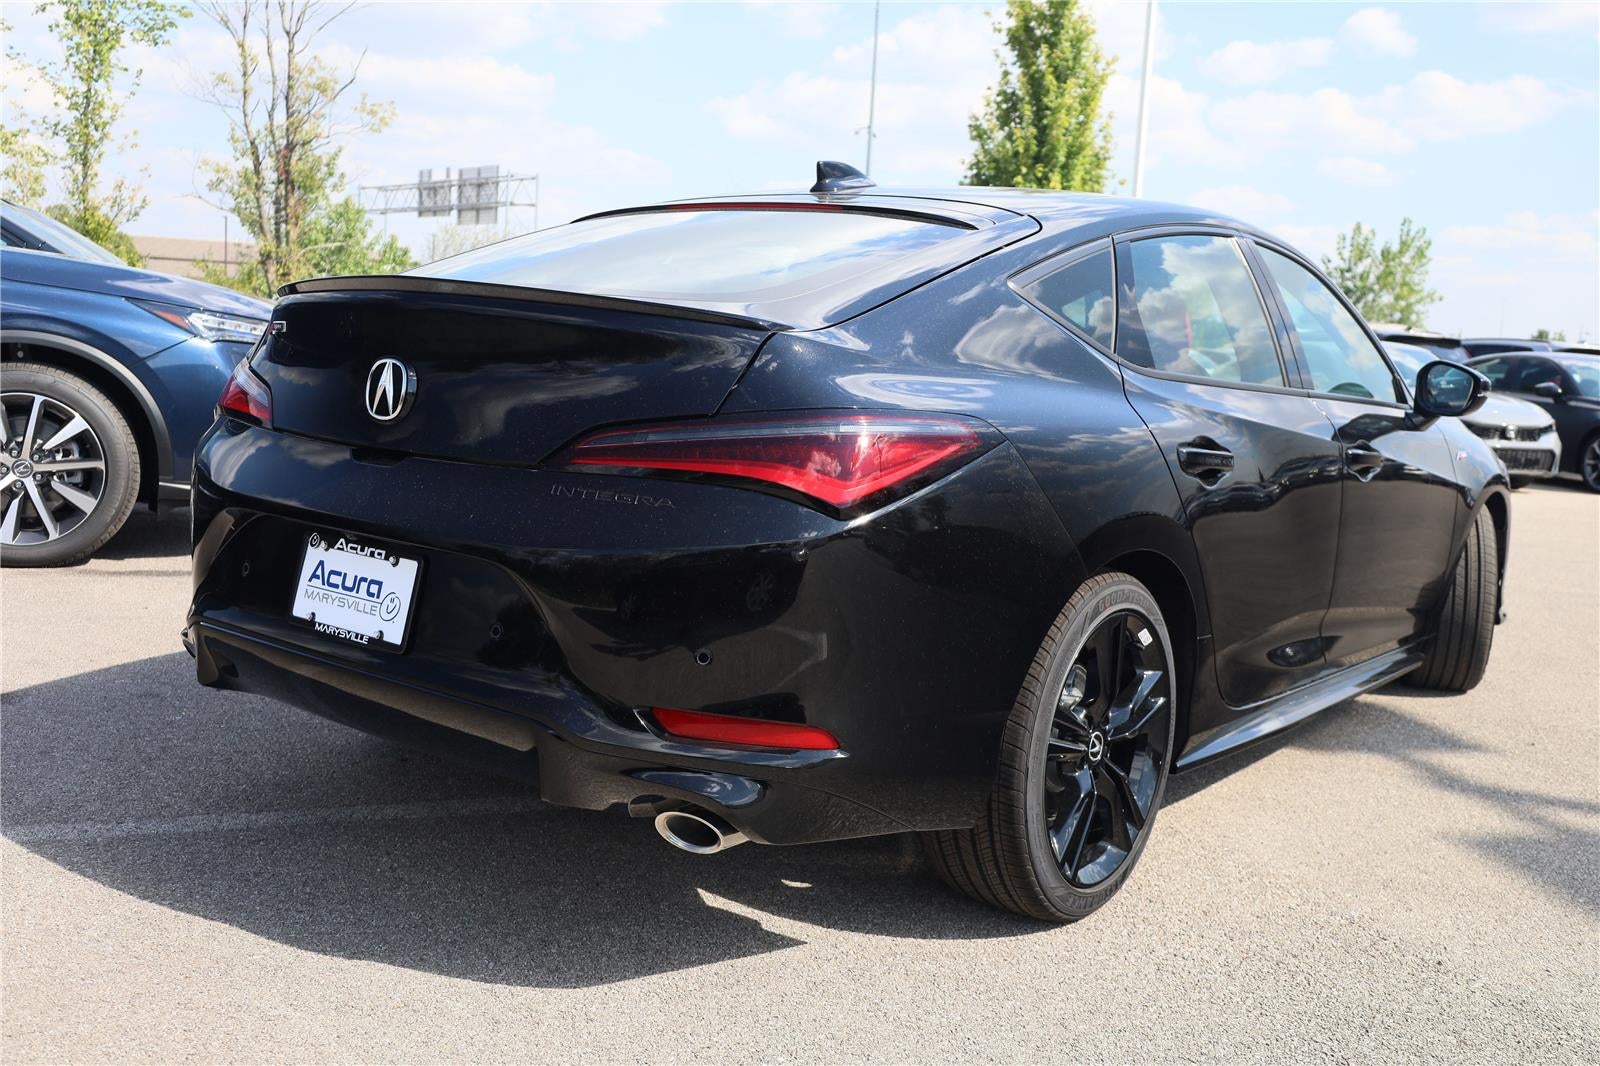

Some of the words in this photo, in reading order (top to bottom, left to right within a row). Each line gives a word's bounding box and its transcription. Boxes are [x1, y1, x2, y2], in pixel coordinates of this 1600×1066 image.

[550, 484, 676, 508] INTEGRA
[334, 538, 386, 560] Acura
[307, 560, 384, 599] Acura
[304, 588, 379, 616] MARYSVILLE
[314, 622, 370, 644] MARYSVILLE
